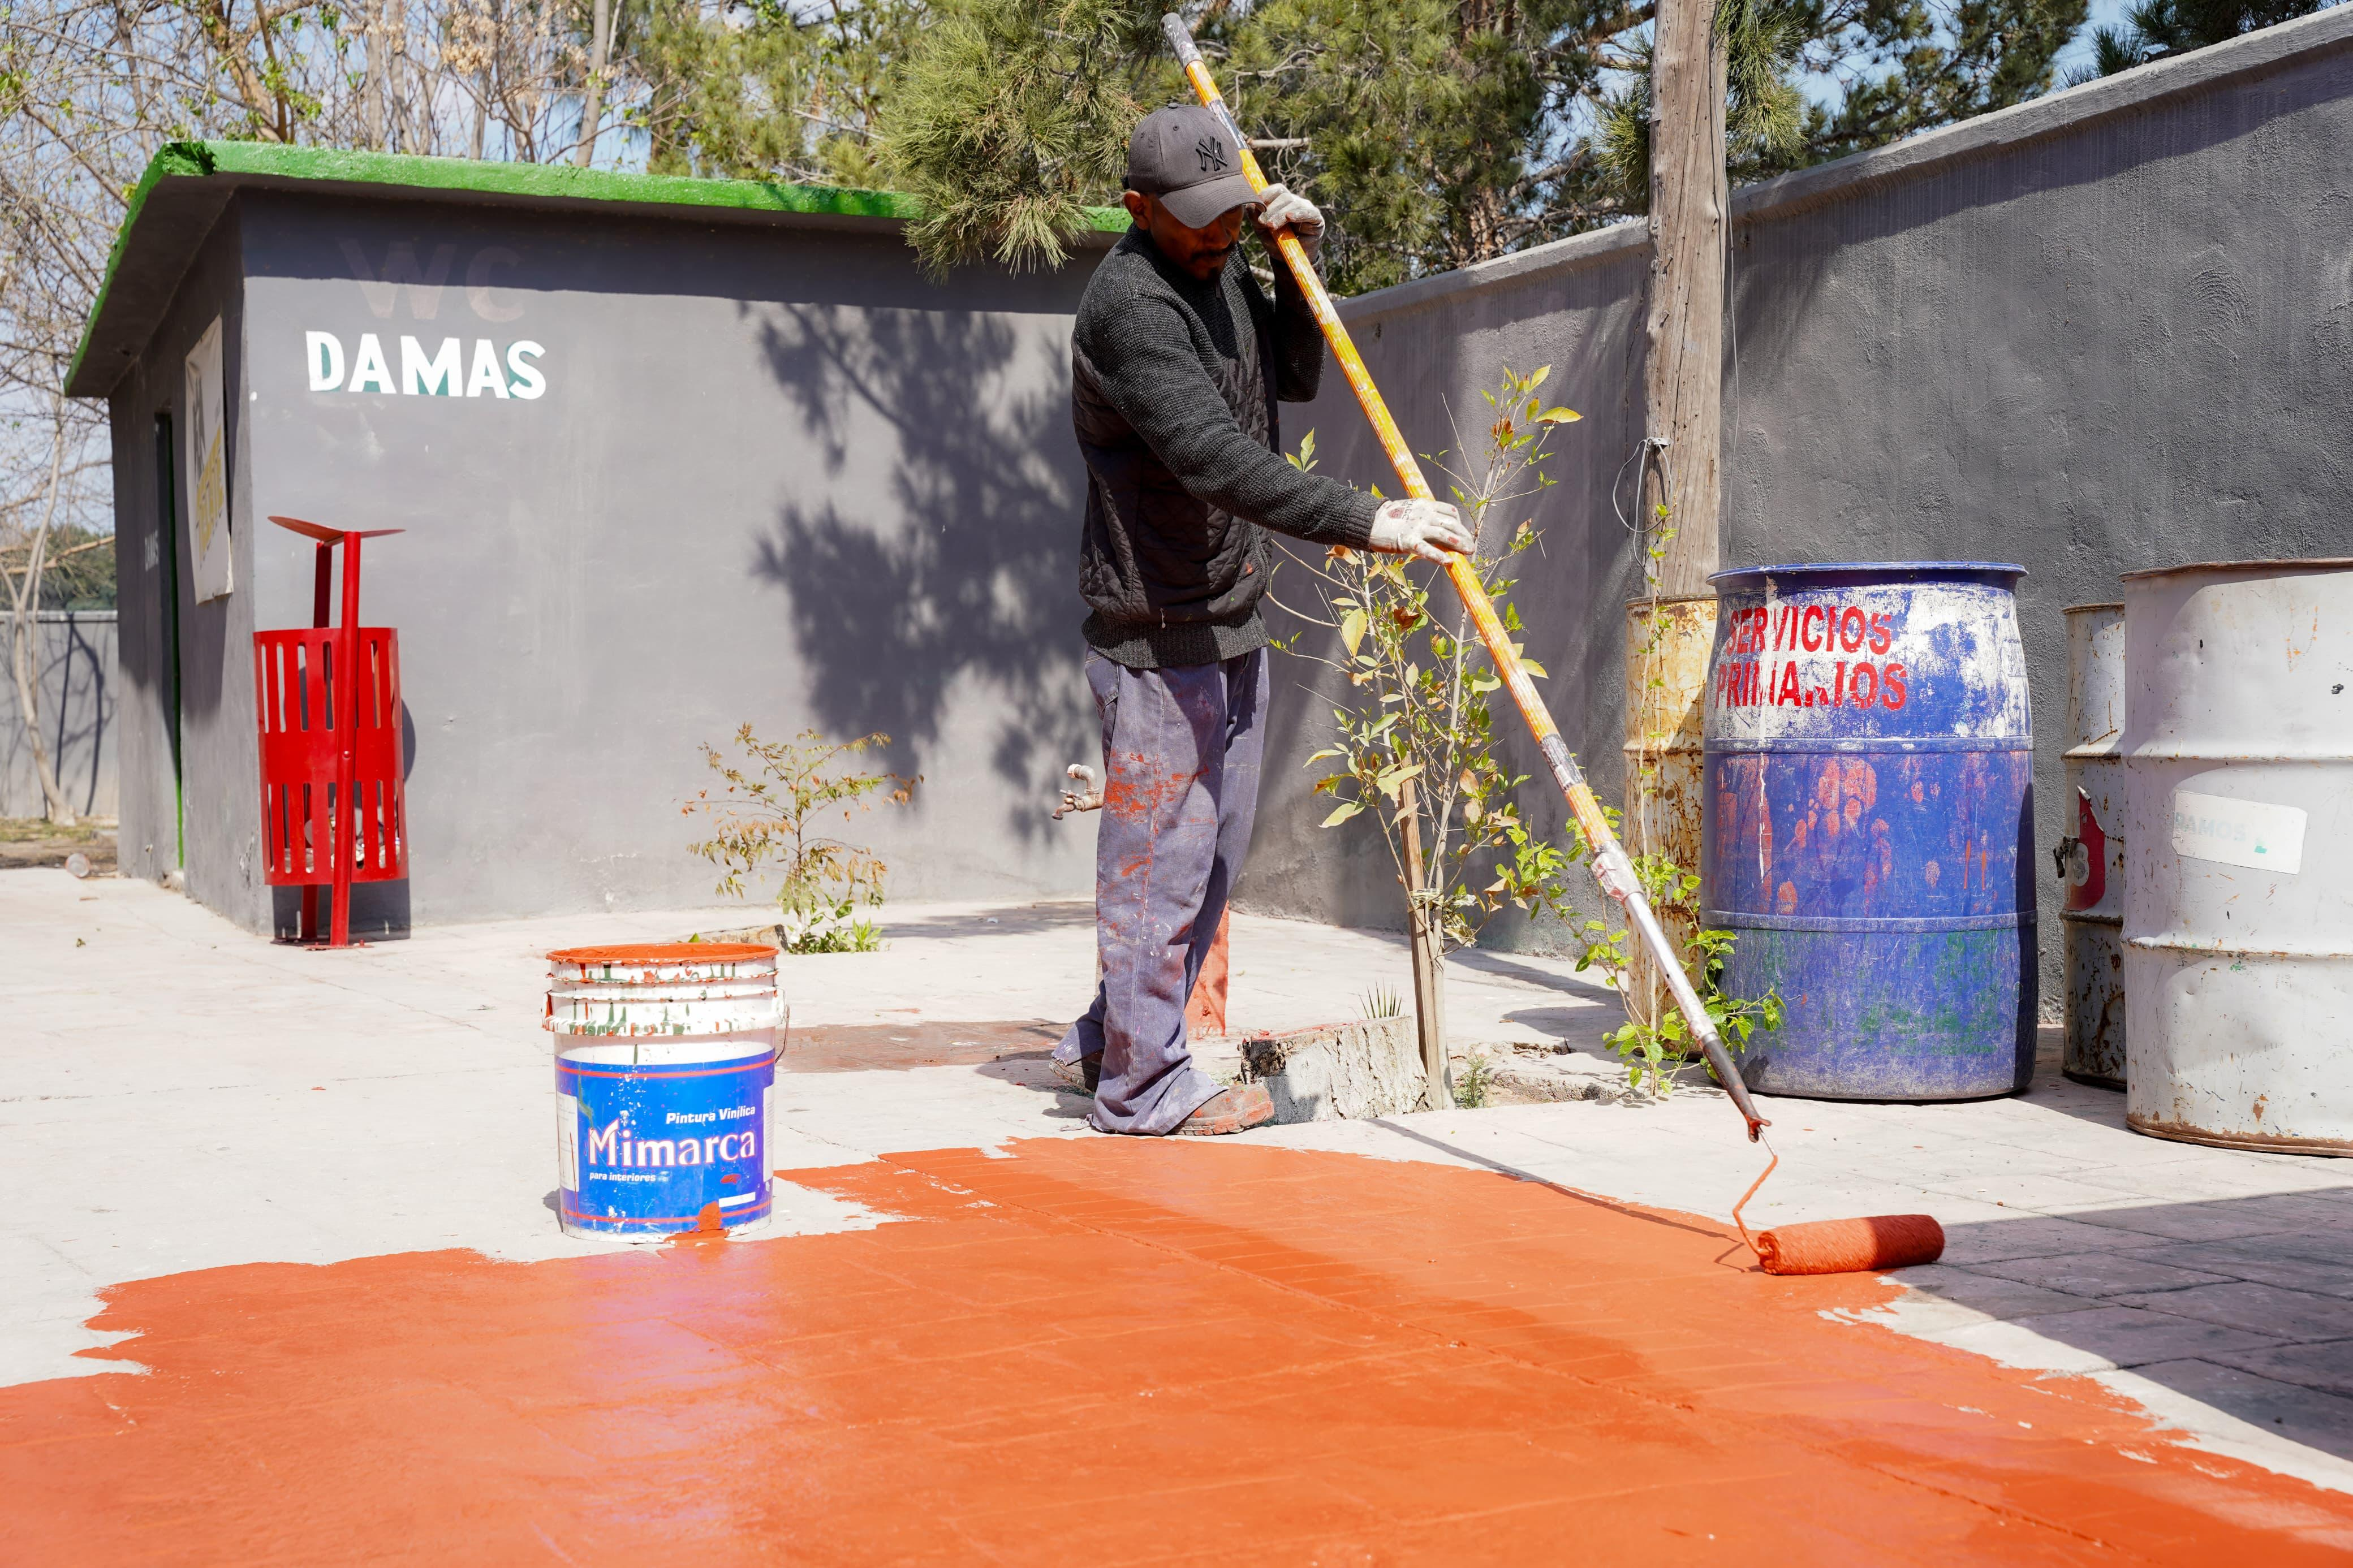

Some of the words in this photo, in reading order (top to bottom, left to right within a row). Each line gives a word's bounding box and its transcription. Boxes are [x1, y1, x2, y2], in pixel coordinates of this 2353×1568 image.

[339, 239, 525, 322] WC
[305, 330, 547, 400] DAMAS
[1726, 605, 1892, 656] SERVICIOS
[666, 1112, 716, 1125] Pintura
[719, 1105, 756, 1120] Vinílica
[588, 1118, 755, 1167] Mimarca
[589, 1172, 607, 1181] para
[609, 1172, 656, 1182] interiores
